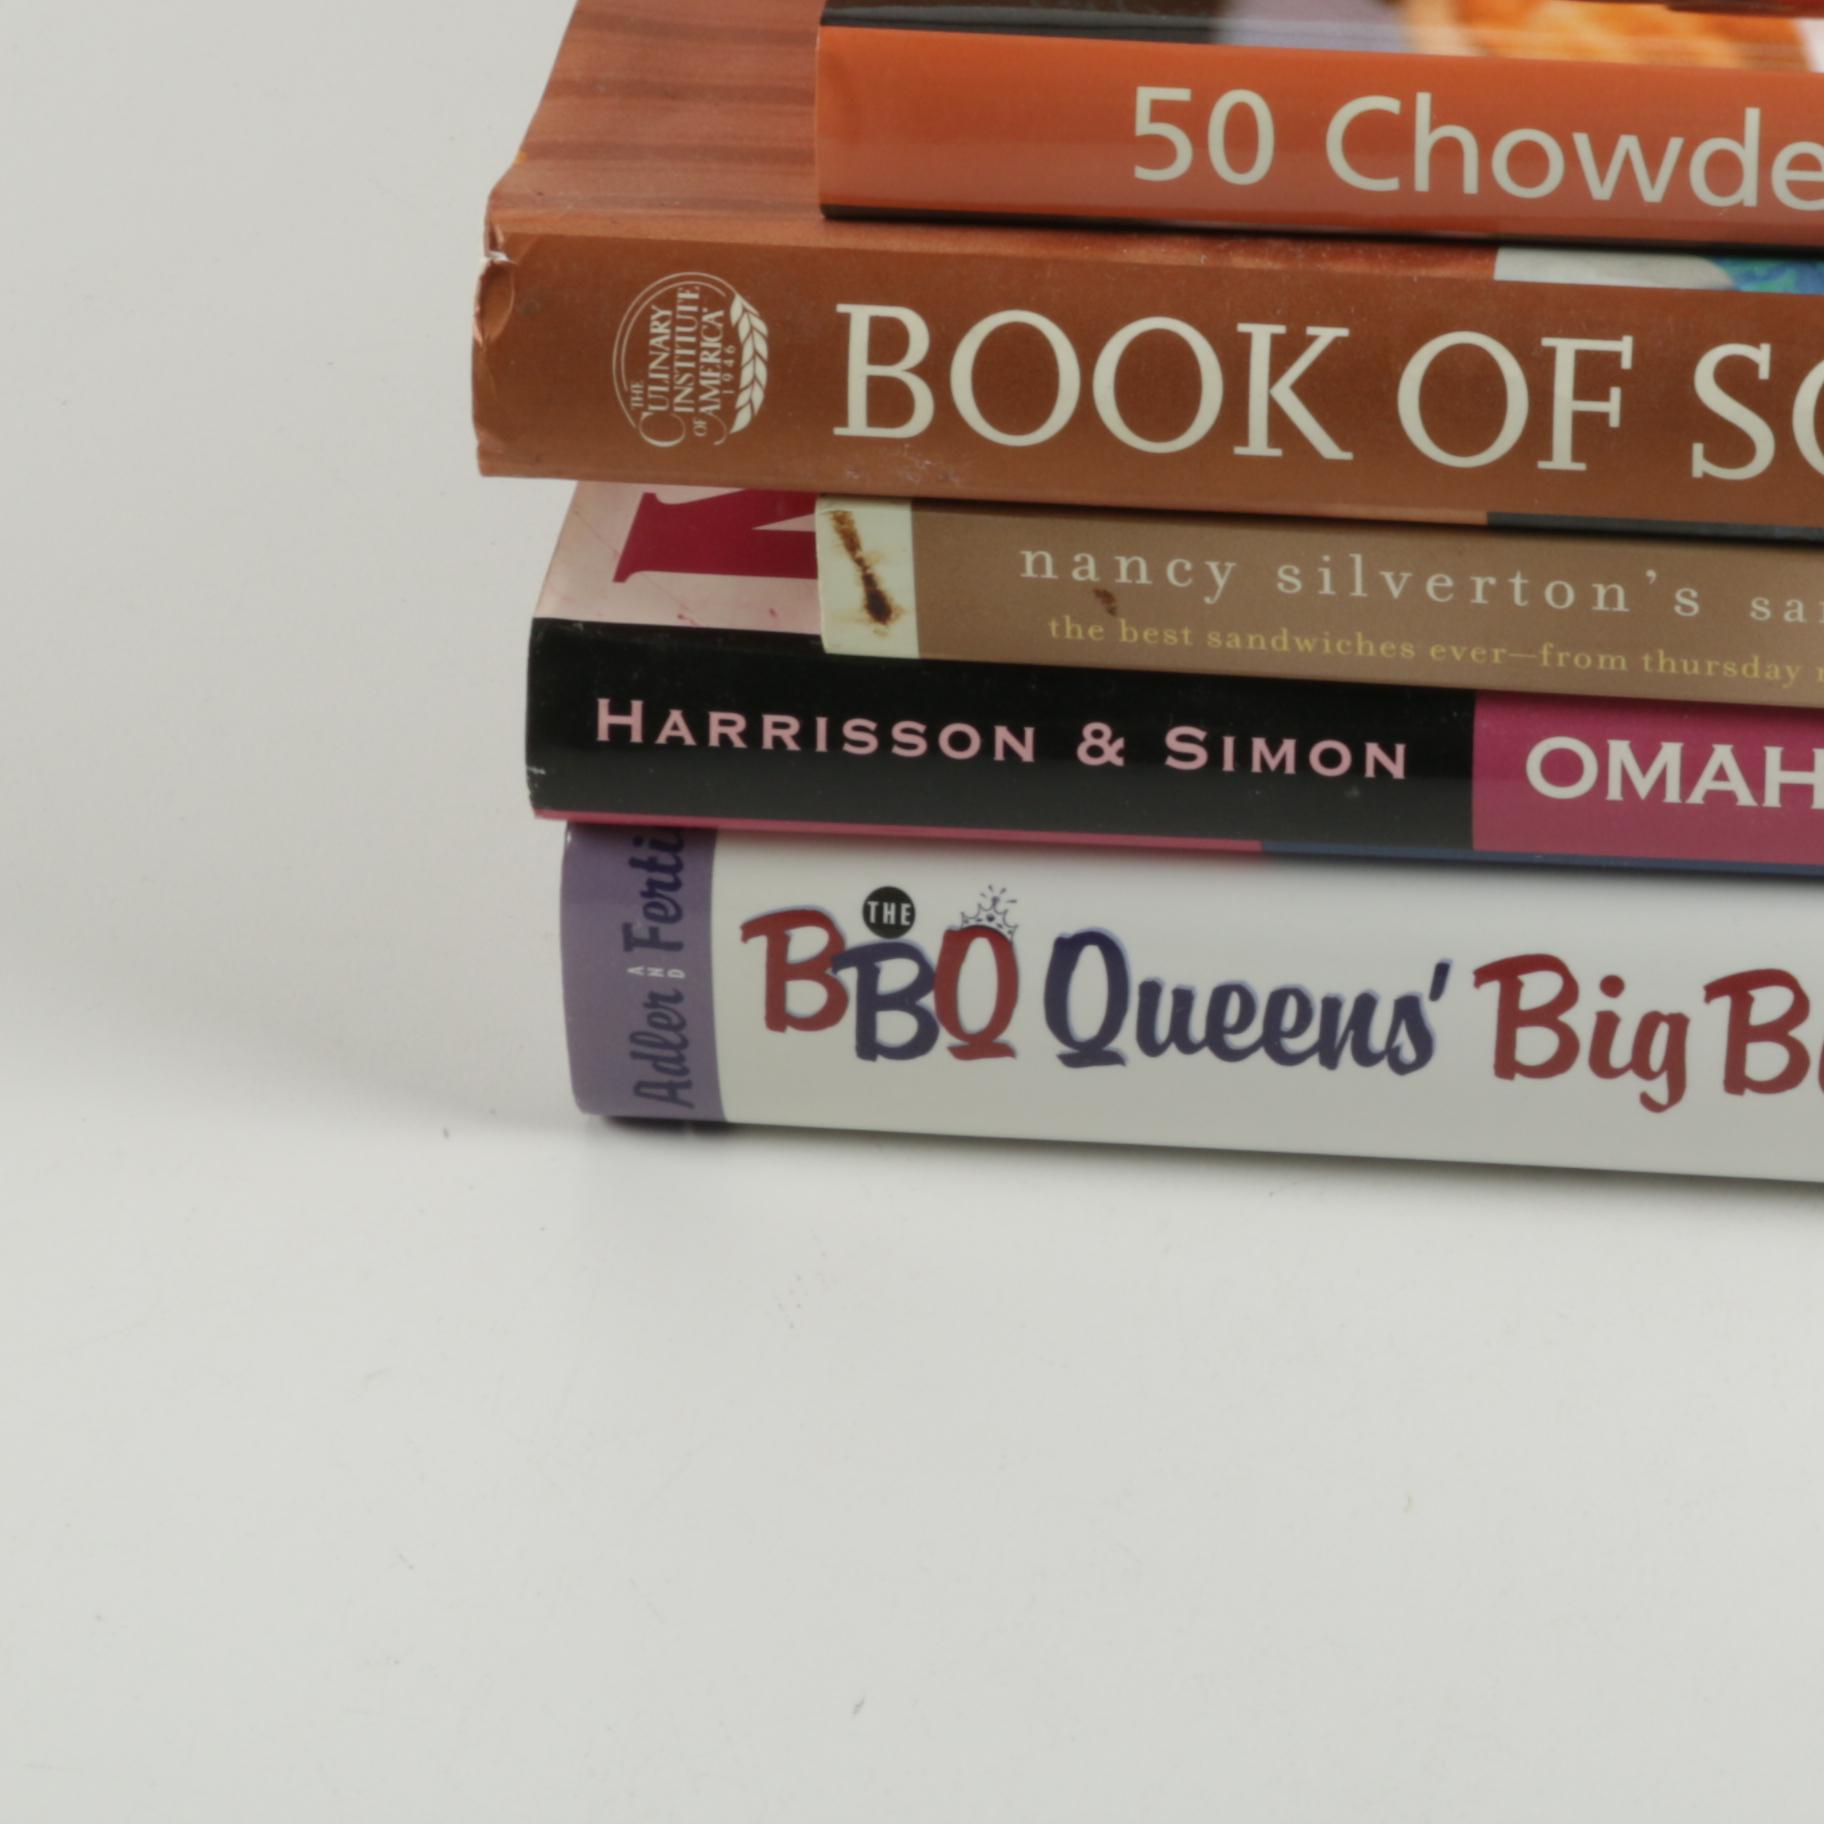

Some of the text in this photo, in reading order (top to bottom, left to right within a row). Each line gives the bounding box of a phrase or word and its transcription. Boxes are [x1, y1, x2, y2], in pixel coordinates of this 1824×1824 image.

[1133, 85, 1275, 186] 50
[673, 287, 700, 413] INSTITUTE
[698, 307, 725, 414] AMERICA
[721, 345, 737, 395] 1946
[832, 302, 1354, 461] BOOK
[1397, 330, 1634, 472] OF
[1019, 547, 1238, 604] nancy
[1276, 552, 1702, 618] silverton's
[1047, 614, 1106, 642] the
[1119, 617, 1193, 647] best
[1206, 625, 1416, 662] sandwiches
[1641, 648, 1803, 689] thursday
[1076, 722, 1126, 767] &
[621, 827, 686, 953] Ferti
[866, 900, 912, 927] THE
[628, 987, 696, 1111] Adler
[740, 906, 1020, 1063] BBQ
[1043, 926, 1453, 1077] Queens'
[1472, 952, 1691, 1114] Big
